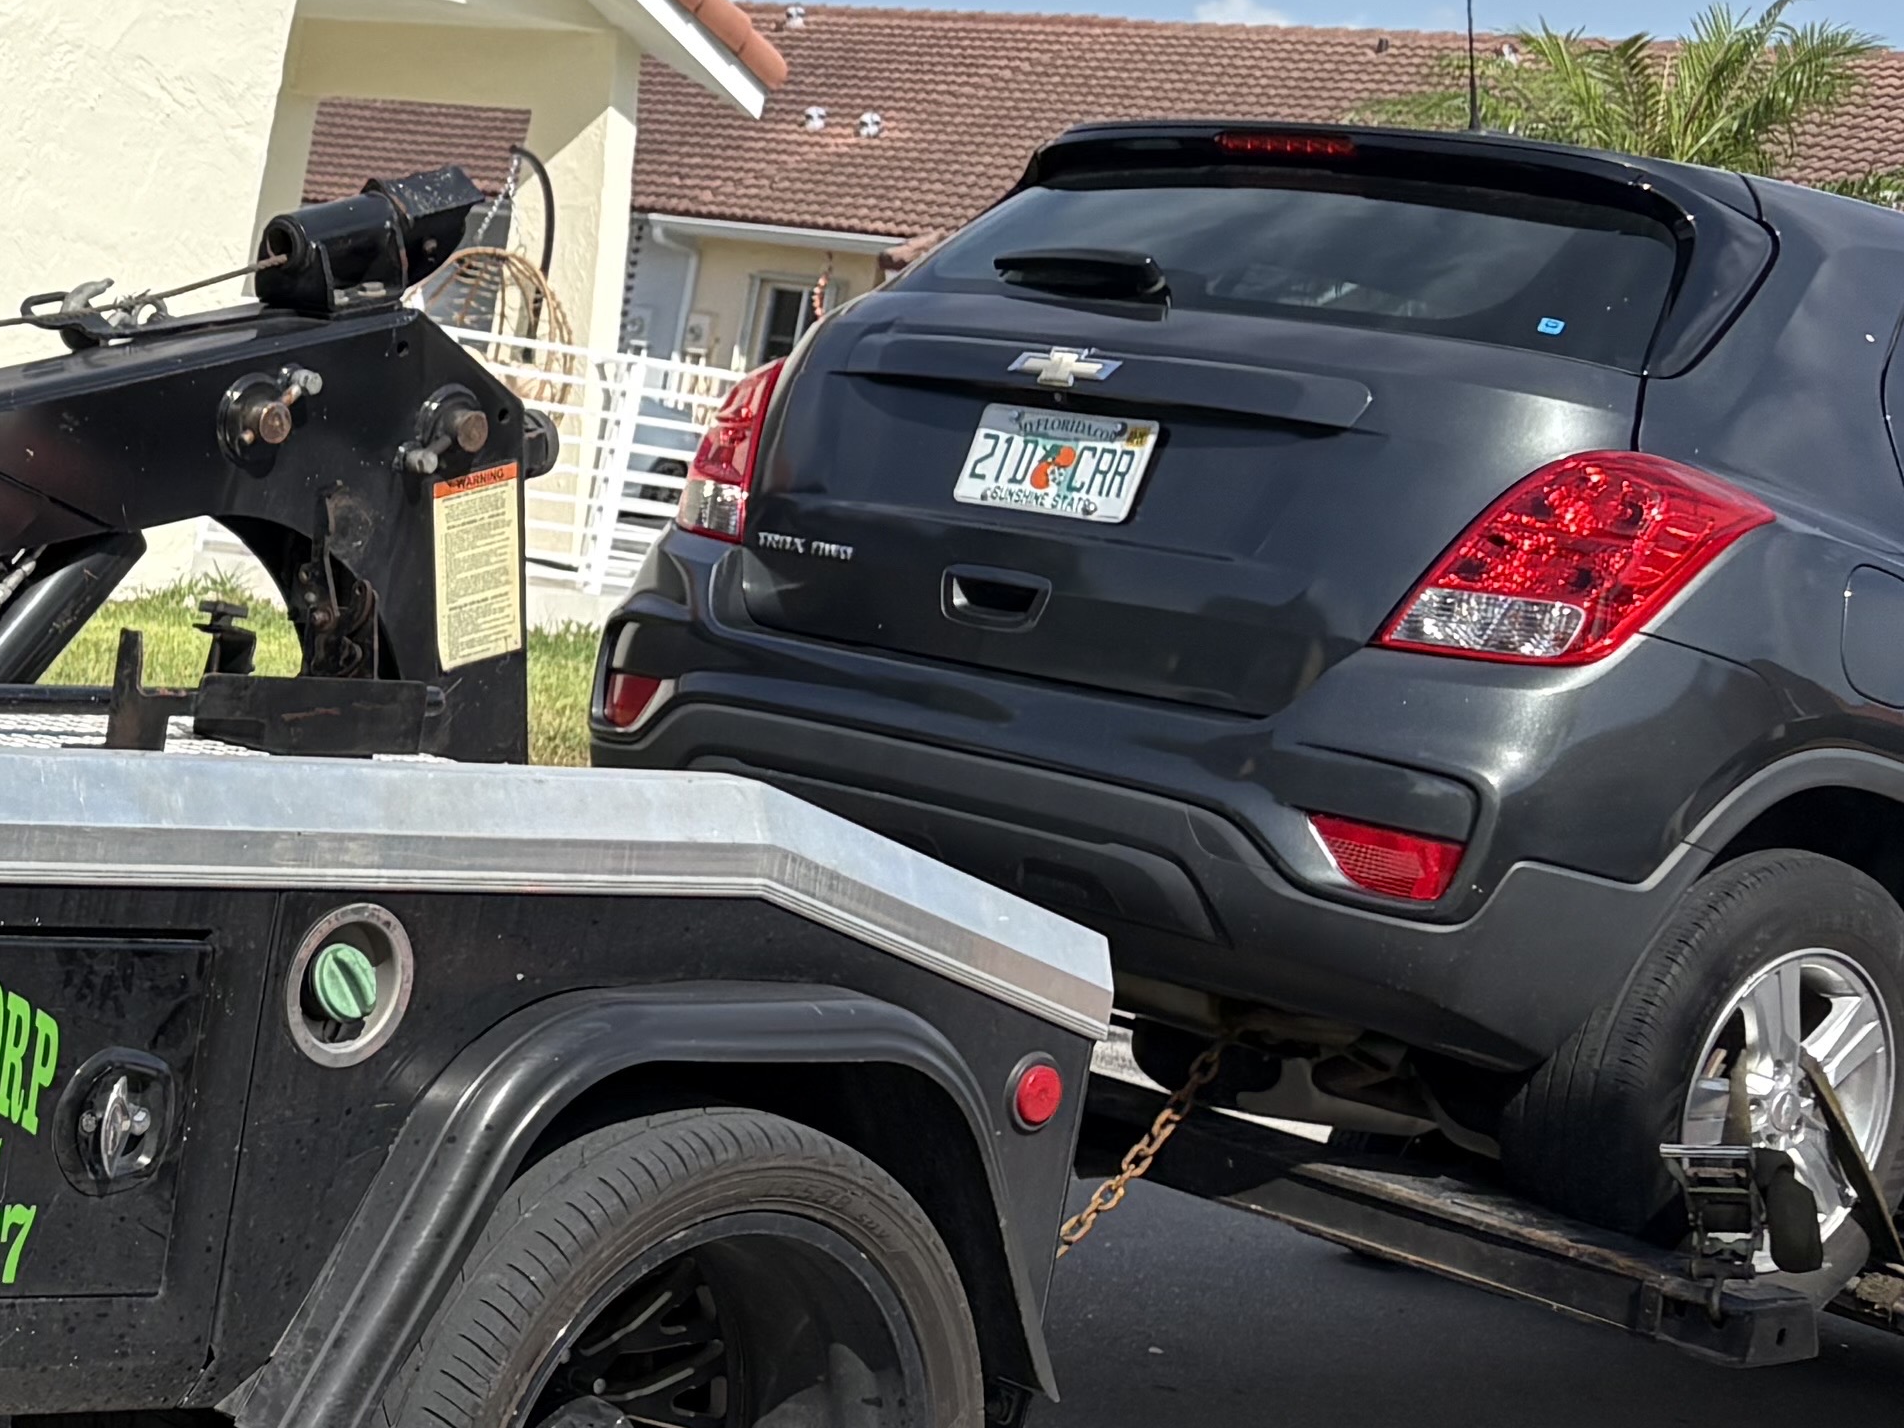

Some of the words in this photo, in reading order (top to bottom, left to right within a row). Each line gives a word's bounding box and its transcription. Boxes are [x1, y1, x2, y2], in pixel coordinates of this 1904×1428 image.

[968, 433, 1039, 485] 21D
[1066, 445, 1136, 499] CRR
[457, 468, 504, 488] WARNING
[990, 485, 1050, 508] SUNSHINE
